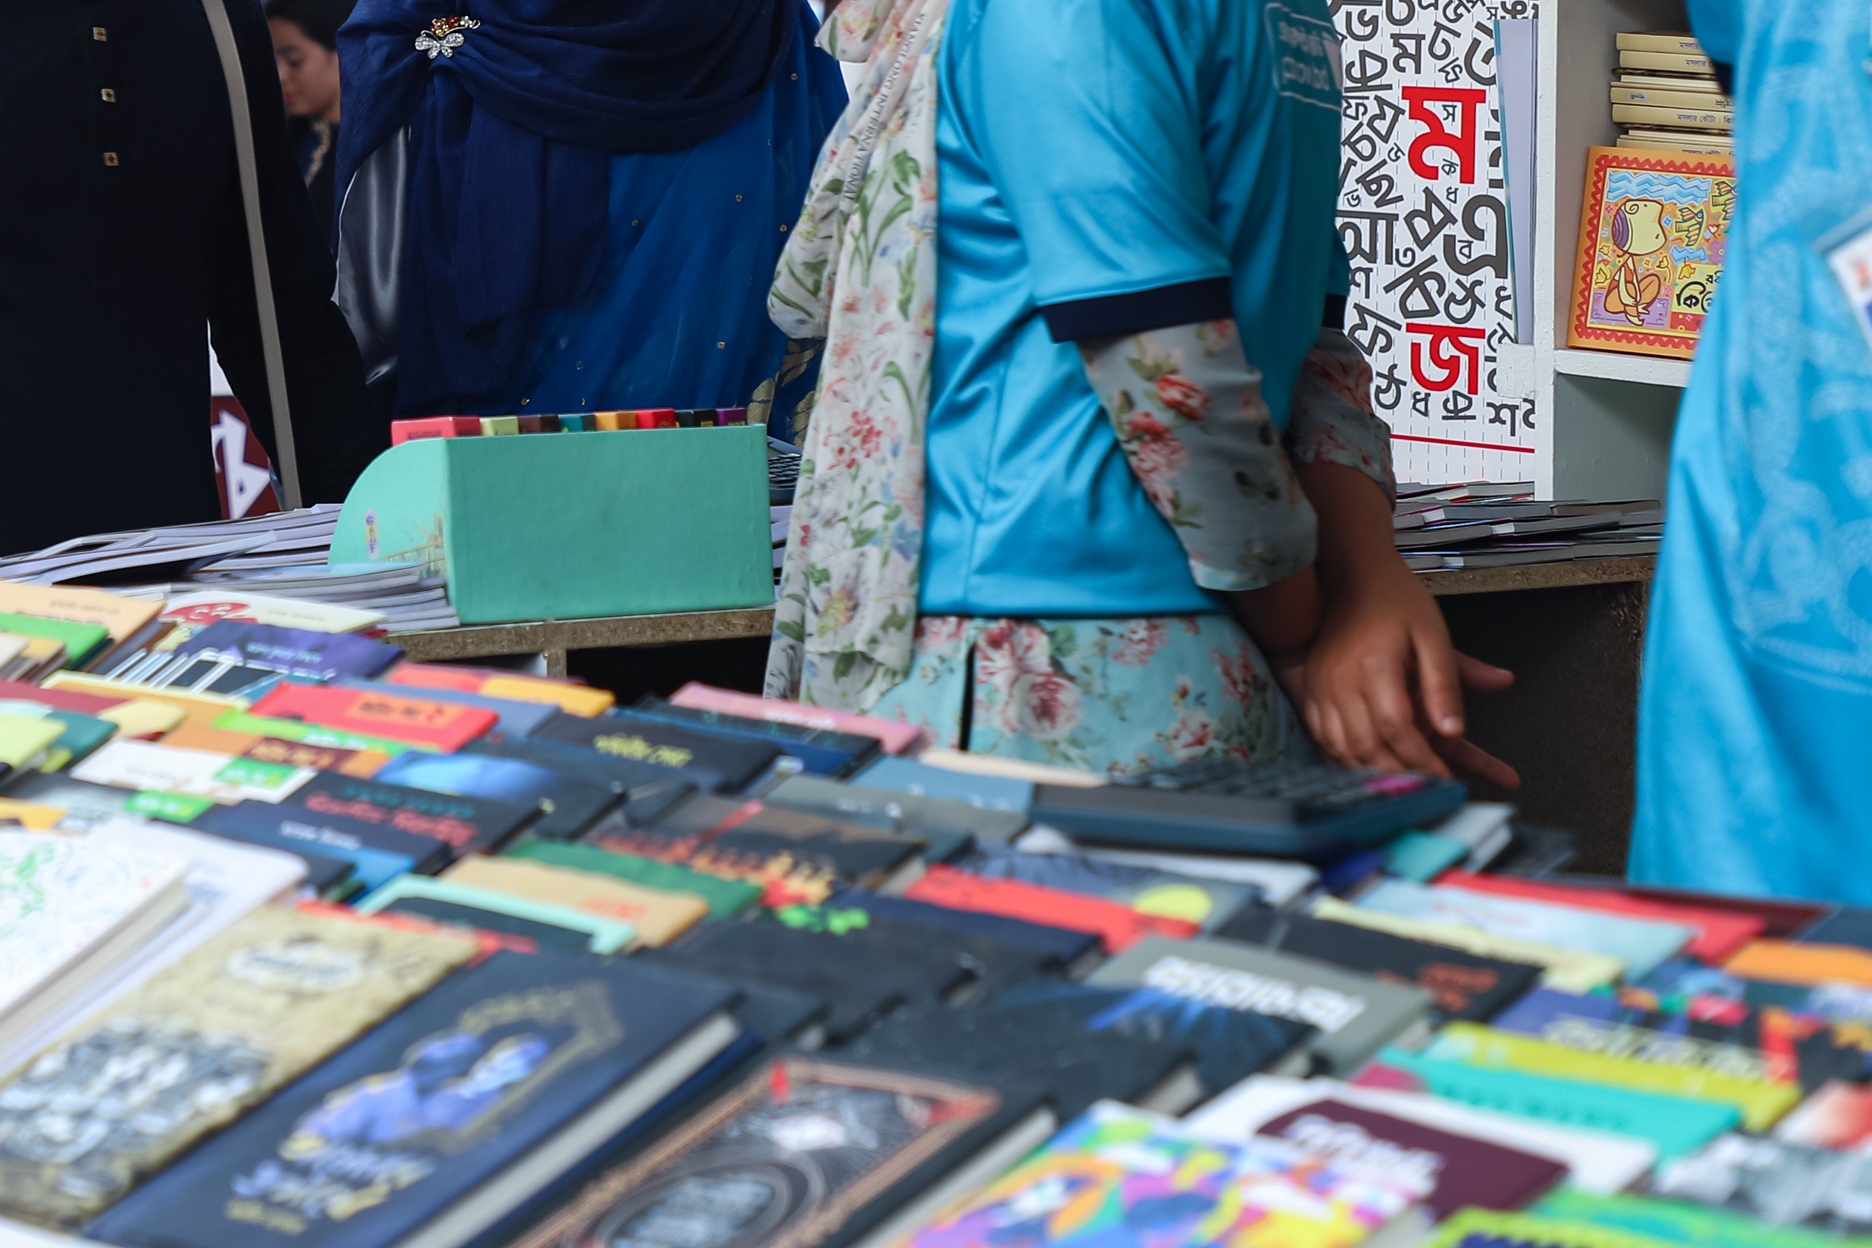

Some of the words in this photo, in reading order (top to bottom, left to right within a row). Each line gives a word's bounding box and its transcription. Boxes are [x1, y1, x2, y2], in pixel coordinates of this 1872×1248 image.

[1390, 29, 1426, 74] ম
[1402, 86, 1486, 184] ম
[1355, 158, 1404, 208] ছ
[1443, 194, 1508, 279] এ
[1383, 255, 1446, 319] ক
[1406, 323, 1485, 395] জ
[1486, 402, 1519, 437] শ
